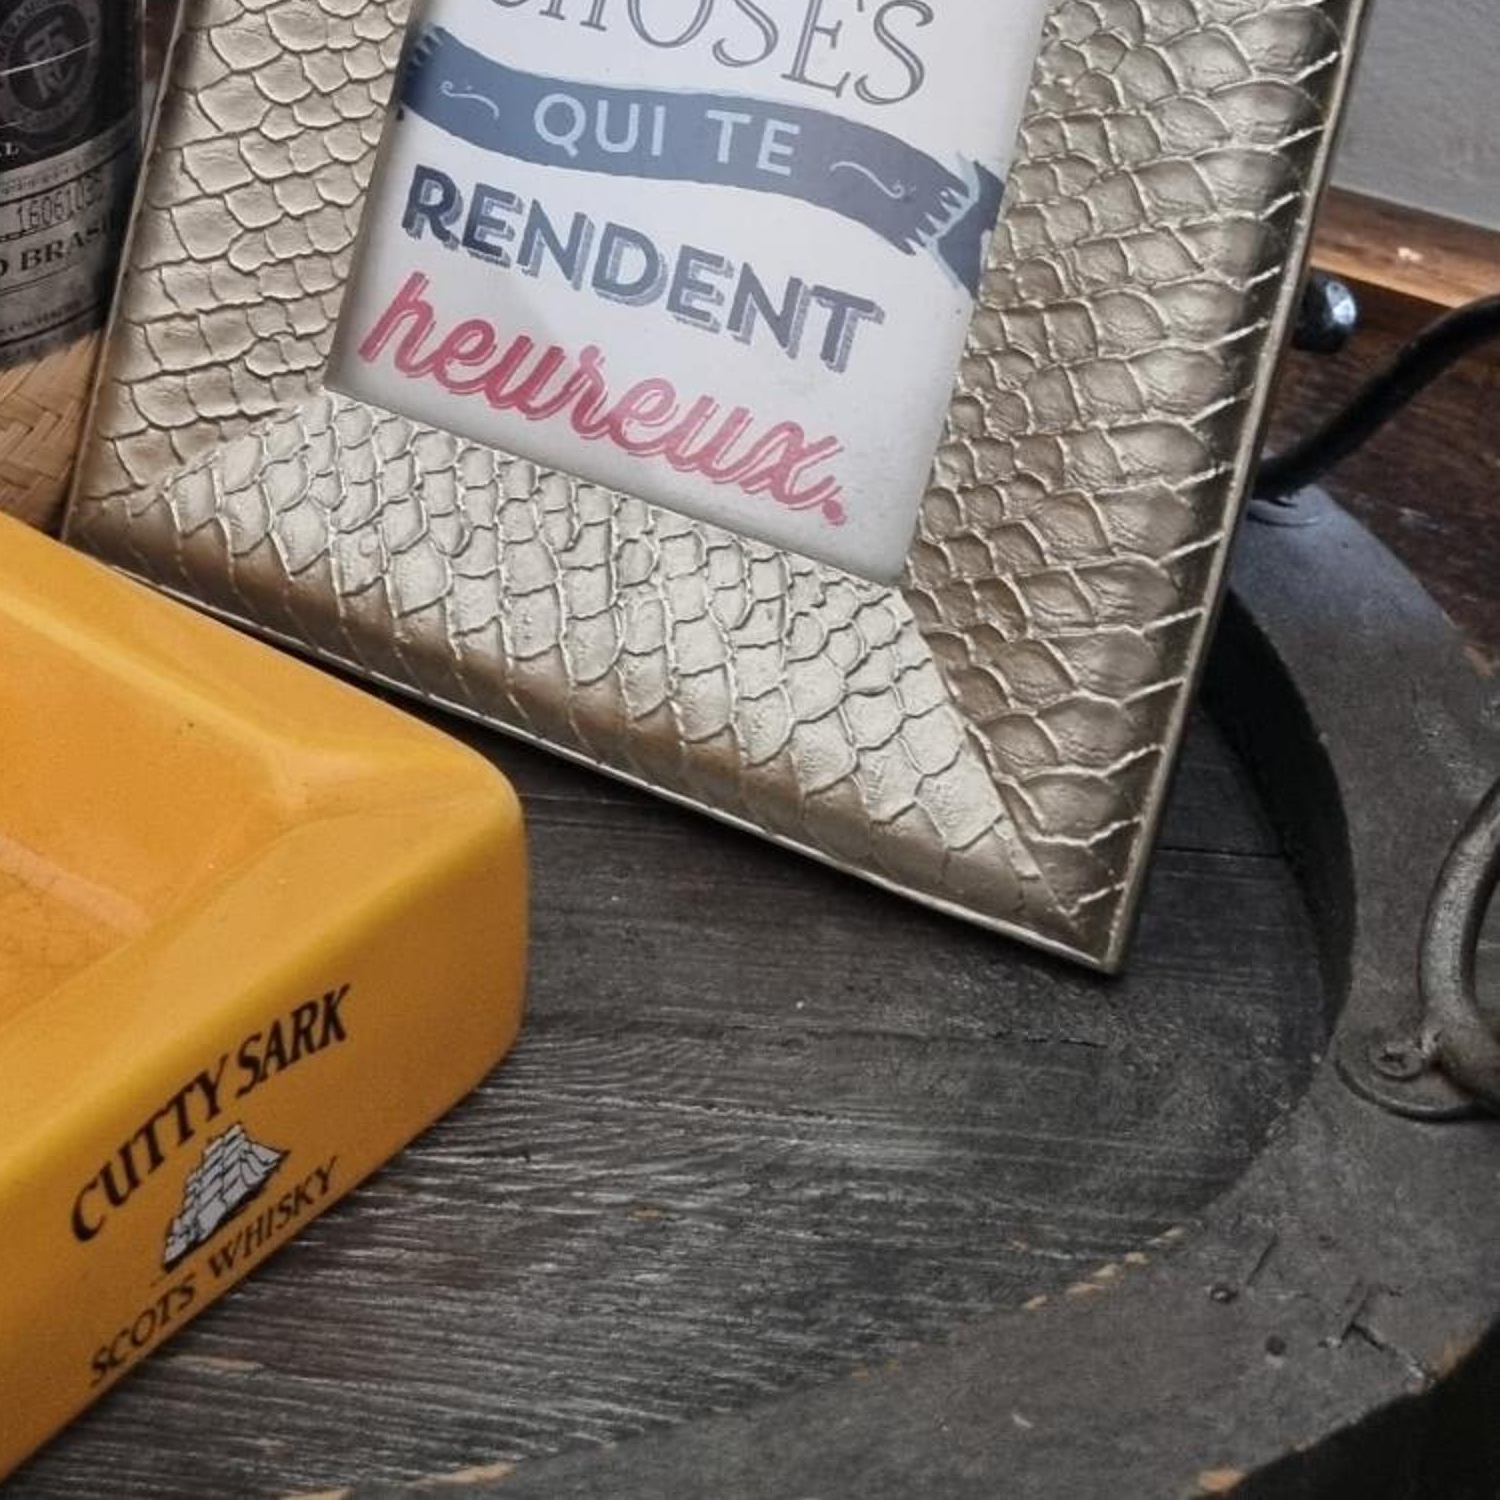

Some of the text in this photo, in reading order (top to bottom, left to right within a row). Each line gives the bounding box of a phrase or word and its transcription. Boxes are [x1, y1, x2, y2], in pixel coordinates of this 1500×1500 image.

[20, 214, 112, 272] BRASI
[532, 92, 802, 176] QUI TE
[400, 162, 885, 375] RENDENT
[357, 271, 849, 528] heureux.
[70, 983, 352, 1243] CUTTY SARK
[90, 1155, 338, 1388] SCOTS WHISKY
